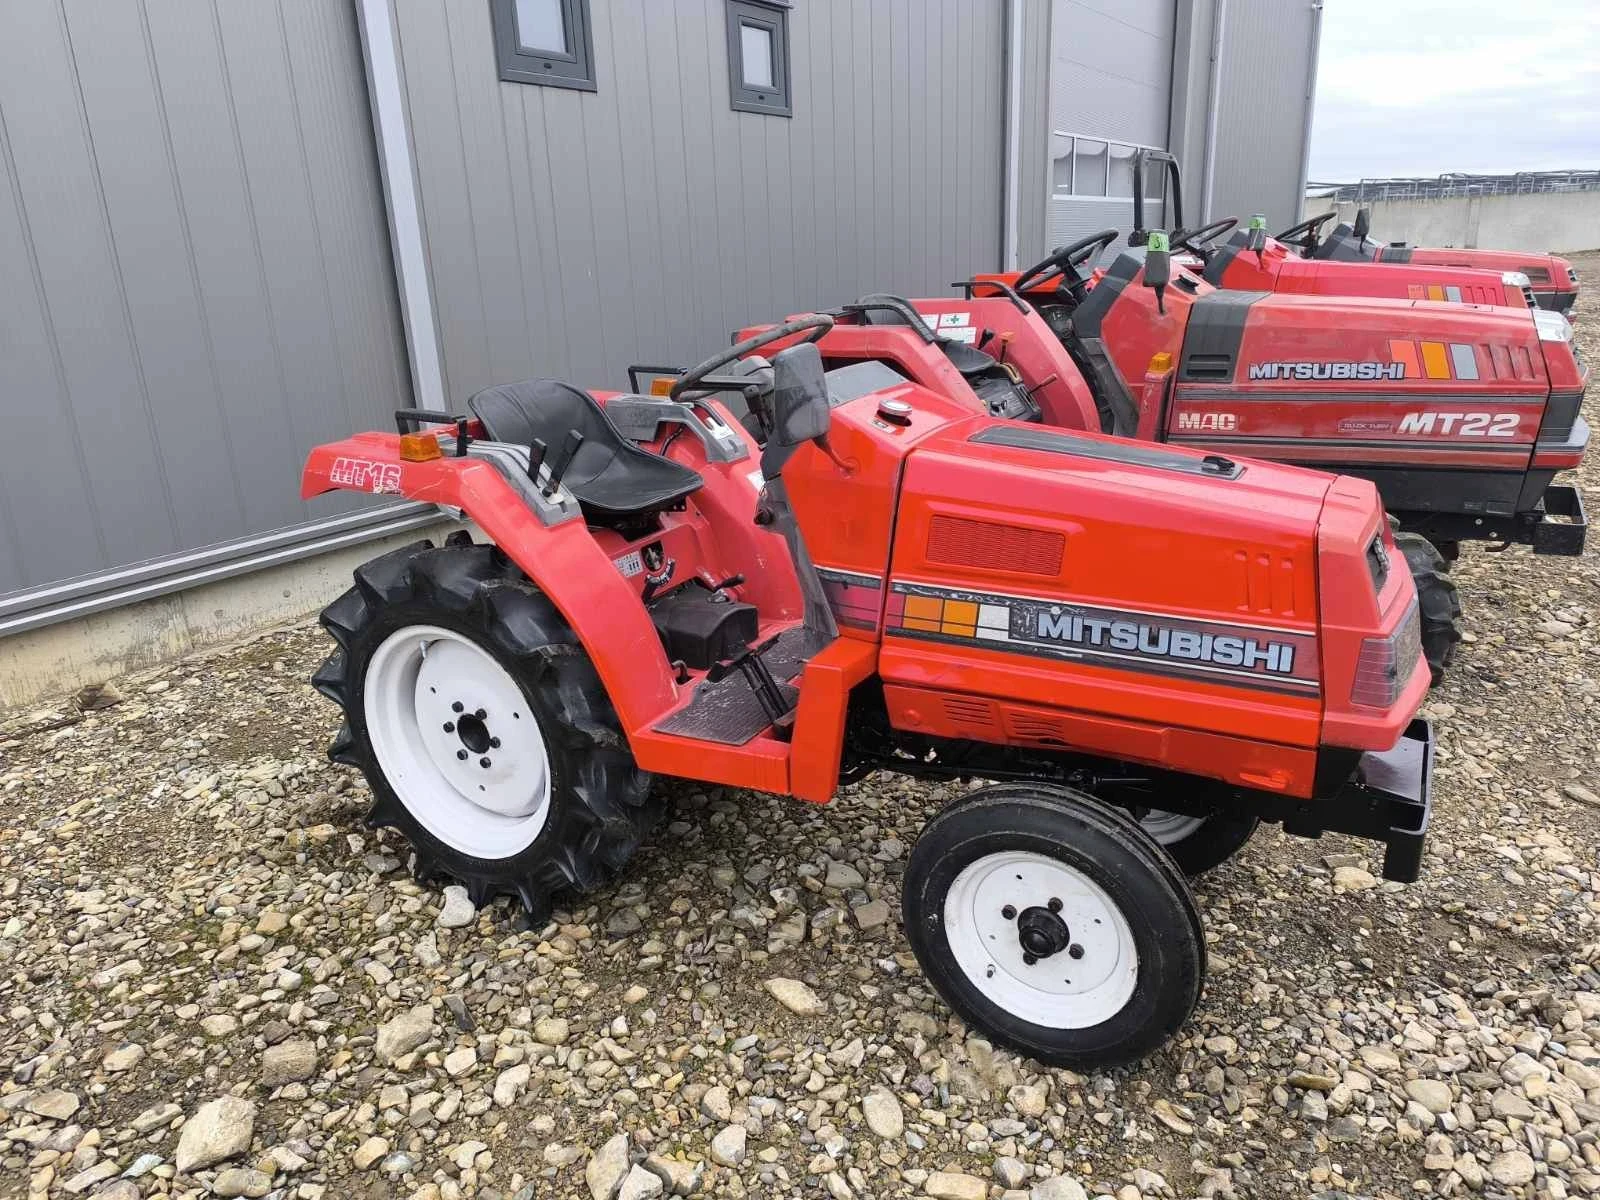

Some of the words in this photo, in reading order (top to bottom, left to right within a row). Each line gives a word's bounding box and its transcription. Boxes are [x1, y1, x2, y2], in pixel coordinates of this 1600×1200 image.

[1249, 362, 1405, 380] MITSUBISHI
[1179, 413, 1236, 430] MAC
[1396, 412, 1520, 437] MT22
[1037, 611, 1293, 673] MITSUBISHI
